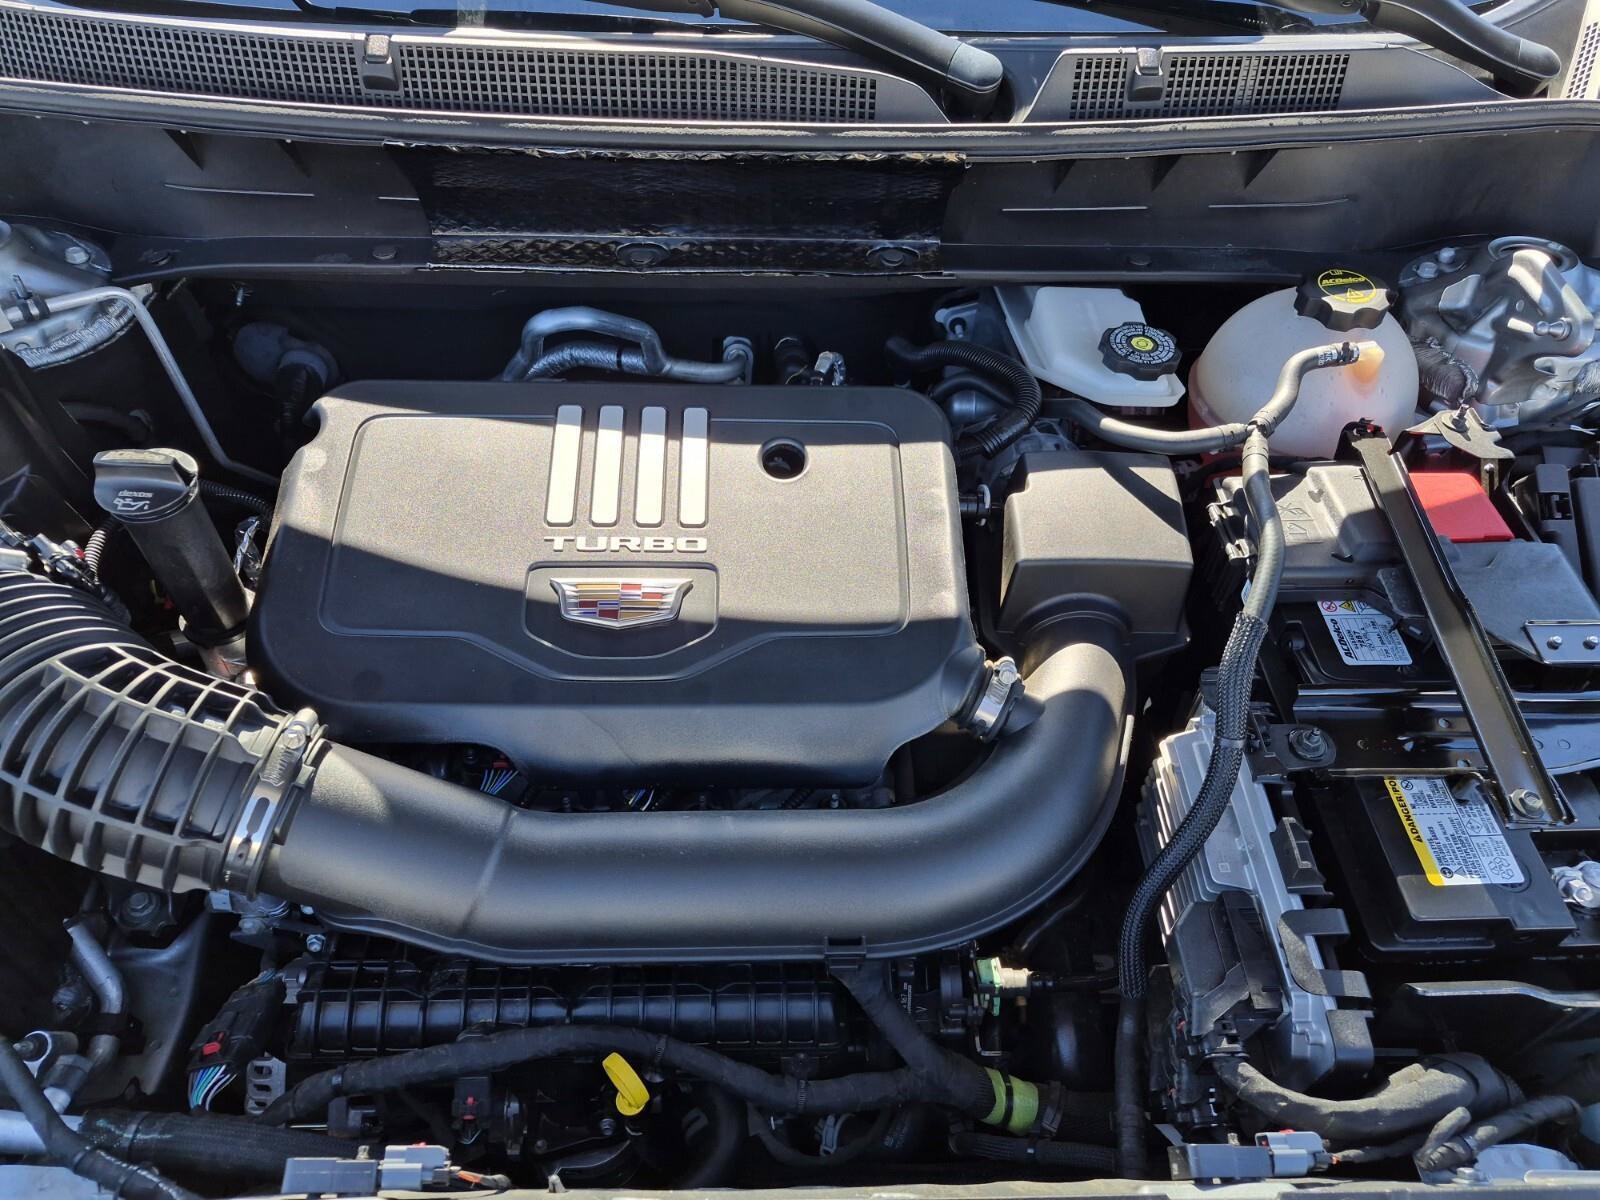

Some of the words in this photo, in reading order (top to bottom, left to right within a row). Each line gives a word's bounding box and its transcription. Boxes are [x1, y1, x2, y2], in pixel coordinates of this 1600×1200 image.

[1321, 277, 1366, 285] ACDelco
[544, 537, 708, 553] TURBO
[1331, 618, 1355, 659] ACDelco
